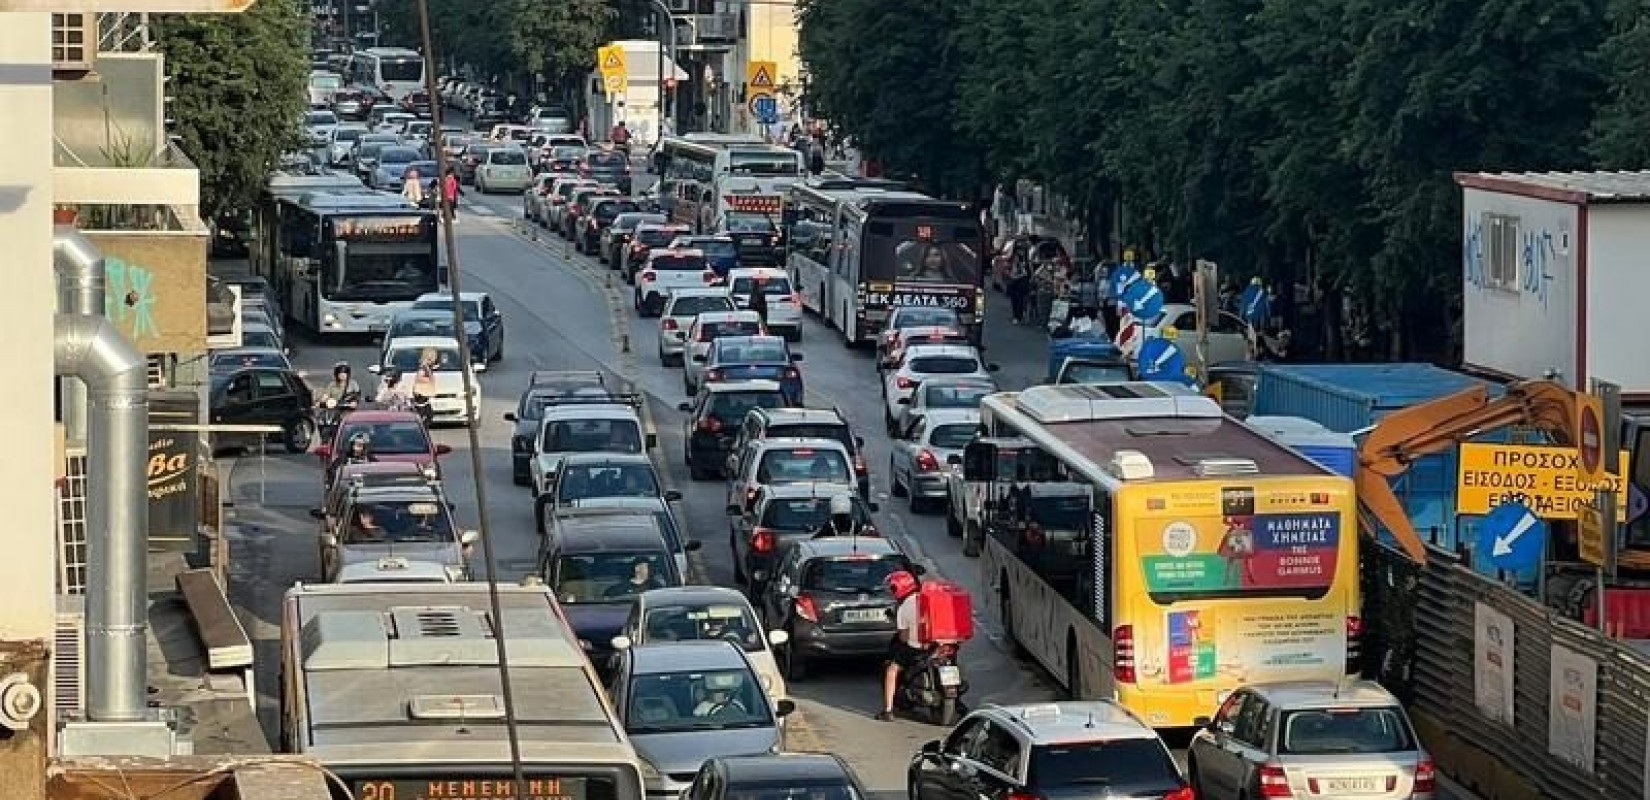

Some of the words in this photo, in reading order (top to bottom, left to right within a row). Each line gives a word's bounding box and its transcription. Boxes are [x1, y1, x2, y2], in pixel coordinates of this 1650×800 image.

[865, 293, 889, 305] ΙΕΚ
[892, 294, 938, 307] ΔΕΛΤΑ
[941, 296, 968, 309] 360
[1494, 451, 1579, 469] ΠΡΟΣΟΧ
[1464, 471, 1537, 490] ΕΙΣΟΔΟΣ
[1554, 475, 1623, 493] ΕΞΟΟΣ
[429, 779, 561, 797] ΜΕΝΕΜΝΗ
